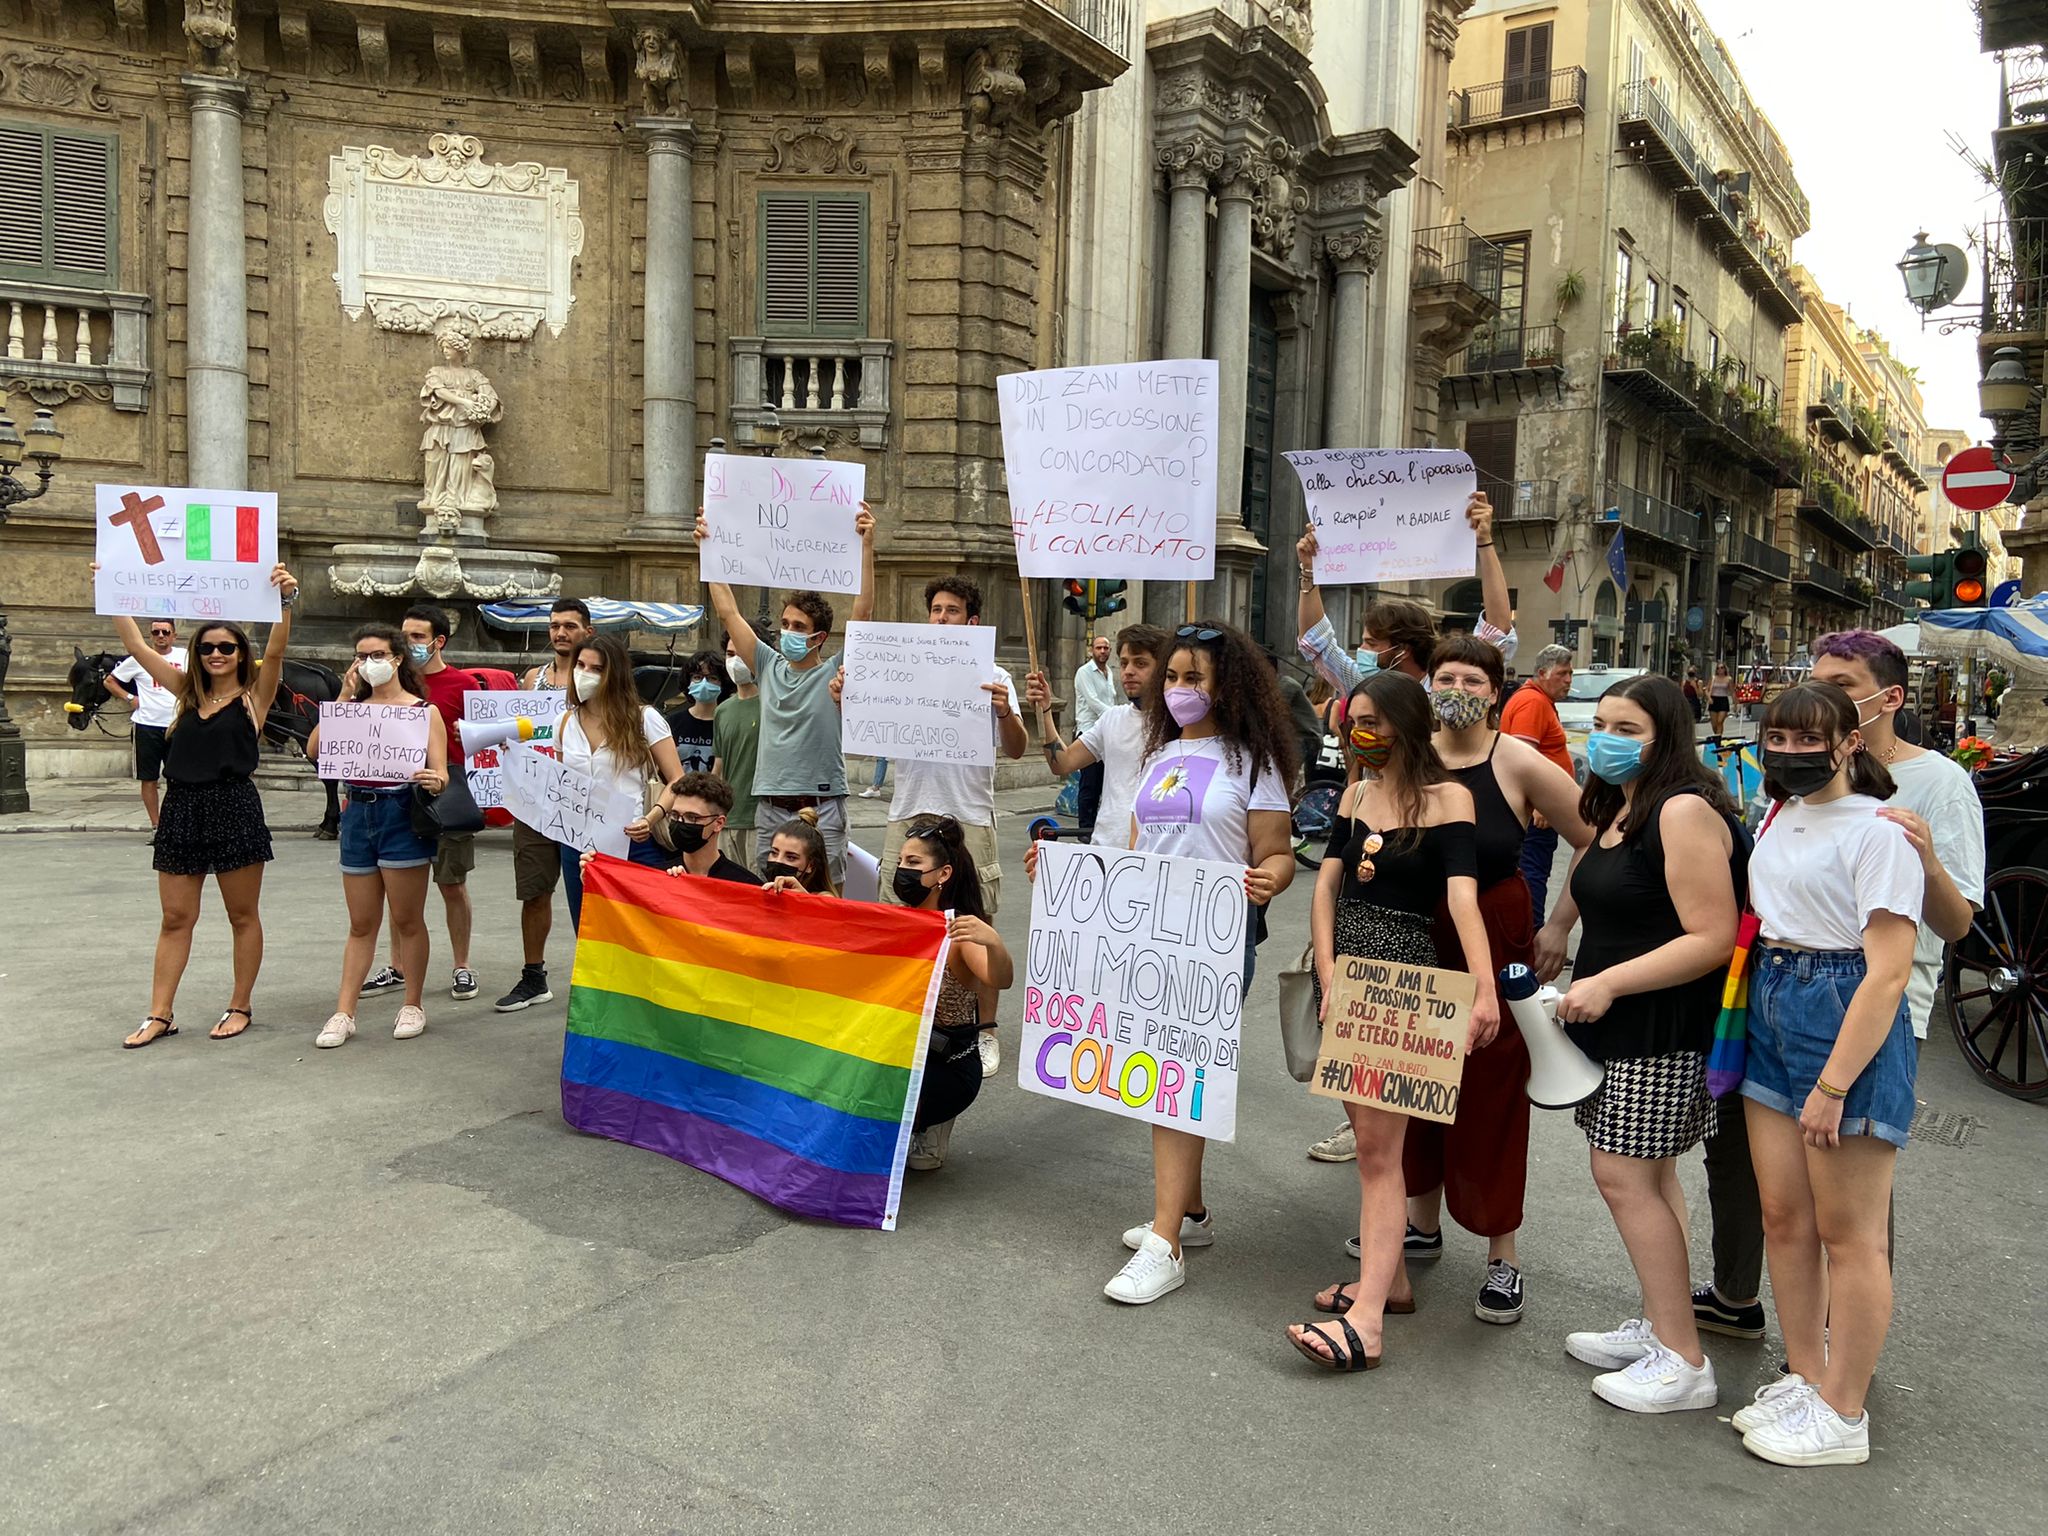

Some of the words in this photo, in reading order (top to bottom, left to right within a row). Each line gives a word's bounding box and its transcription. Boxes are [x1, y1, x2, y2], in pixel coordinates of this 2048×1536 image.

[1015, 376, 1050, 404] DDL
[1062, 371, 1118, 397] ZAN
[1138, 370, 1210, 396] METTE
[1027, 407, 1045, 432] IN
[1066, 404, 1205, 432] DISCUSSIONE
[809, 469, 852, 506] ZAN
[1306, 472, 1335, 491] alla
[1346, 468, 1405, 489] chiesa,
[758, 503, 789, 529] NO
[1409, 509, 1451, 527] BADIALE
[713, 525, 744, 548] ALLE
[770, 531, 848, 554] INGERENZE
[1049, 533, 1206, 561] CONCORDATO
[1360, 537, 1397, 557] people
[114, 571, 176, 586] CHIESA
[200, 575, 250, 591] STATO
[721, 555, 746, 575] DEL
[765, 556, 854, 587] VATICANO
[854, 631, 874, 642] 300
[853, 648, 906, 663] SCANDALI
[911, 655, 921, 664] DI
[925, 652, 978, 667] PEDOFILIA
[853, 665, 867, 682] 8
[884, 669, 915, 683] 1000
[380, 706, 426, 721] CHIESA
[470, 697, 498, 720] PER
[872, 695, 901, 706] MILIARDI
[904, 696, 914, 705] DI
[917, 697, 940, 708] TASSE
[942, 698, 961, 711] NON
[963, 700, 991, 713] PAGATE
[368, 723, 382, 738] IN
[678, 736, 712, 745] bauha
[319, 740, 363, 756] LIBERO
[473, 749, 500, 769] PER
[915, 749, 942, 759] WHAT
[946, 750, 978, 760] ELSE?
[520, 755, 538, 778] Ti
[553, 767, 588, 797] Vedo
[1145, 824, 1187, 834] SUNSHINE
[1029, 929, 1079, 991] UN
[1092, 935, 1243, 1031] MONDO
[1346, 960, 1391, 985] QUINDI
[1395, 969, 1421, 991] AMA
[1425, 974, 1437, 994] IL
[1363, 984, 1421, 1011] PROSSIMO
[1425, 998, 1456, 1019] TUO
[1025, 987, 1108, 1039] ROSA
[1114, 1011, 1134, 1044] E
[1347, 1000, 1377, 1022] SOLO
[1383, 1009, 1399, 1027] SE
[1357, 1024, 1399, 1047] ETERO
[1352, 1052, 1372, 1066] DDL
[1376, 1057, 1394, 1070] ZAN
[1397, 1060, 1428, 1077] SUBITO
[1320, 1058, 1459, 1116] #IONONCONCORDO
